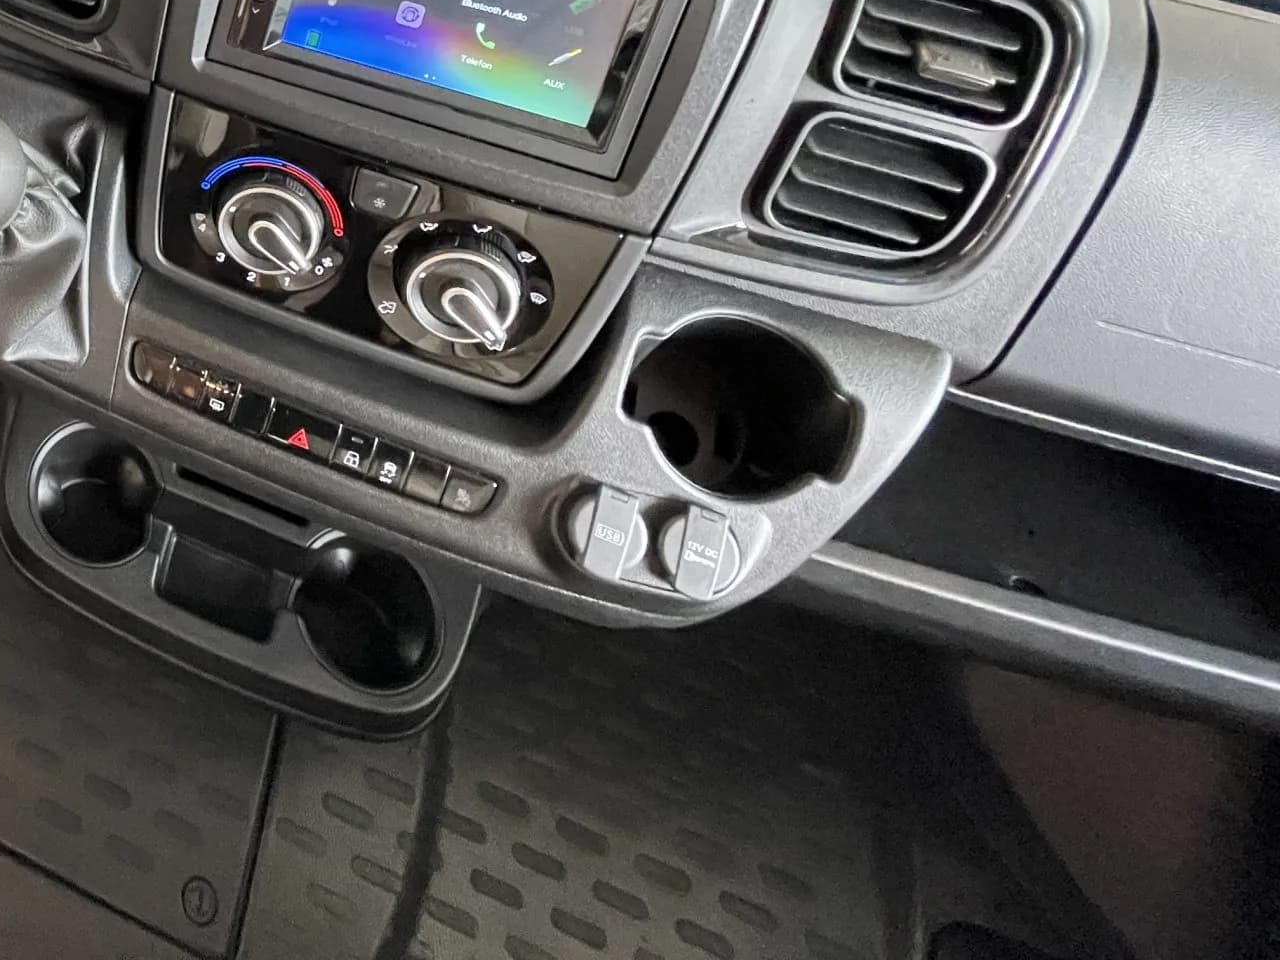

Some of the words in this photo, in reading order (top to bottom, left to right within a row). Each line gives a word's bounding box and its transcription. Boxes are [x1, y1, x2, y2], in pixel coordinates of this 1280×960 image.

[502, 8, 528, 23] Audio
[460, 54, 494, 71] Telefon
[543, 78, 566, 91] AUX
[215, 252, 226, 263] 3
[246, 272, 257, 283] 2
[283, 277, 290, 286] 1
[598, 525, 623, 543] USB
[687, 540, 705, 554] 12V
[704, 548, 719, 560] DC
